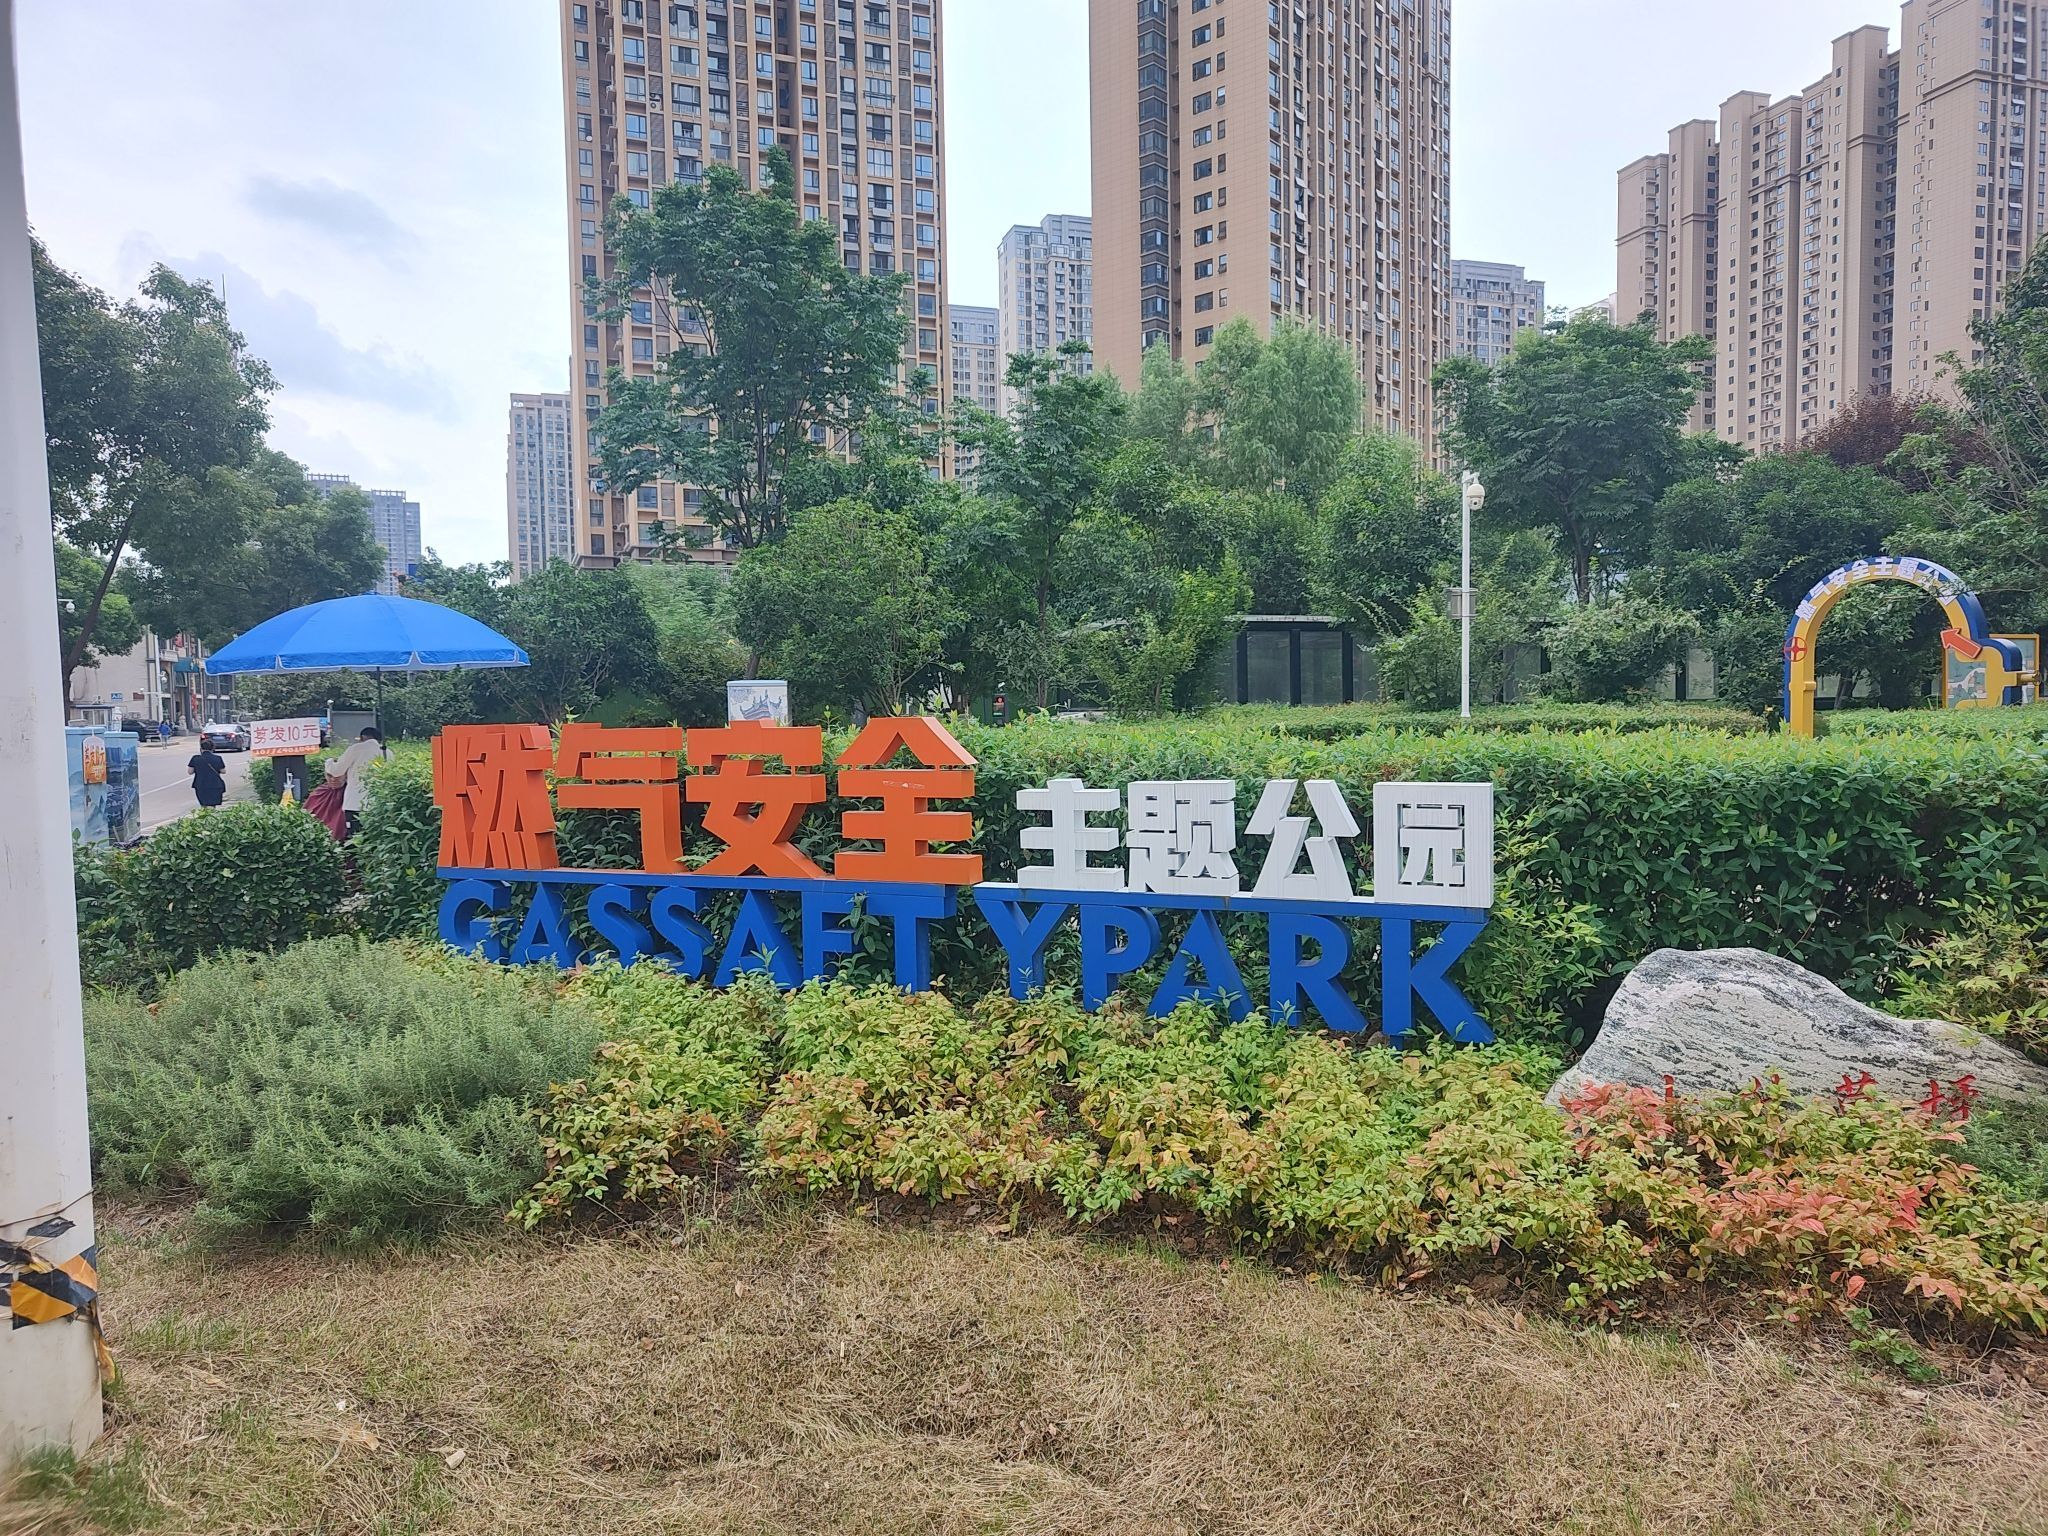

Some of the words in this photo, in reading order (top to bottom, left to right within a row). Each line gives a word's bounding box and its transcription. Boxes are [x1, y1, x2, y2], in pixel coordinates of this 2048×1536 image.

[431, 715, 982, 885] 燃气安全
[1015, 778, 1494, 909] 主题公园
